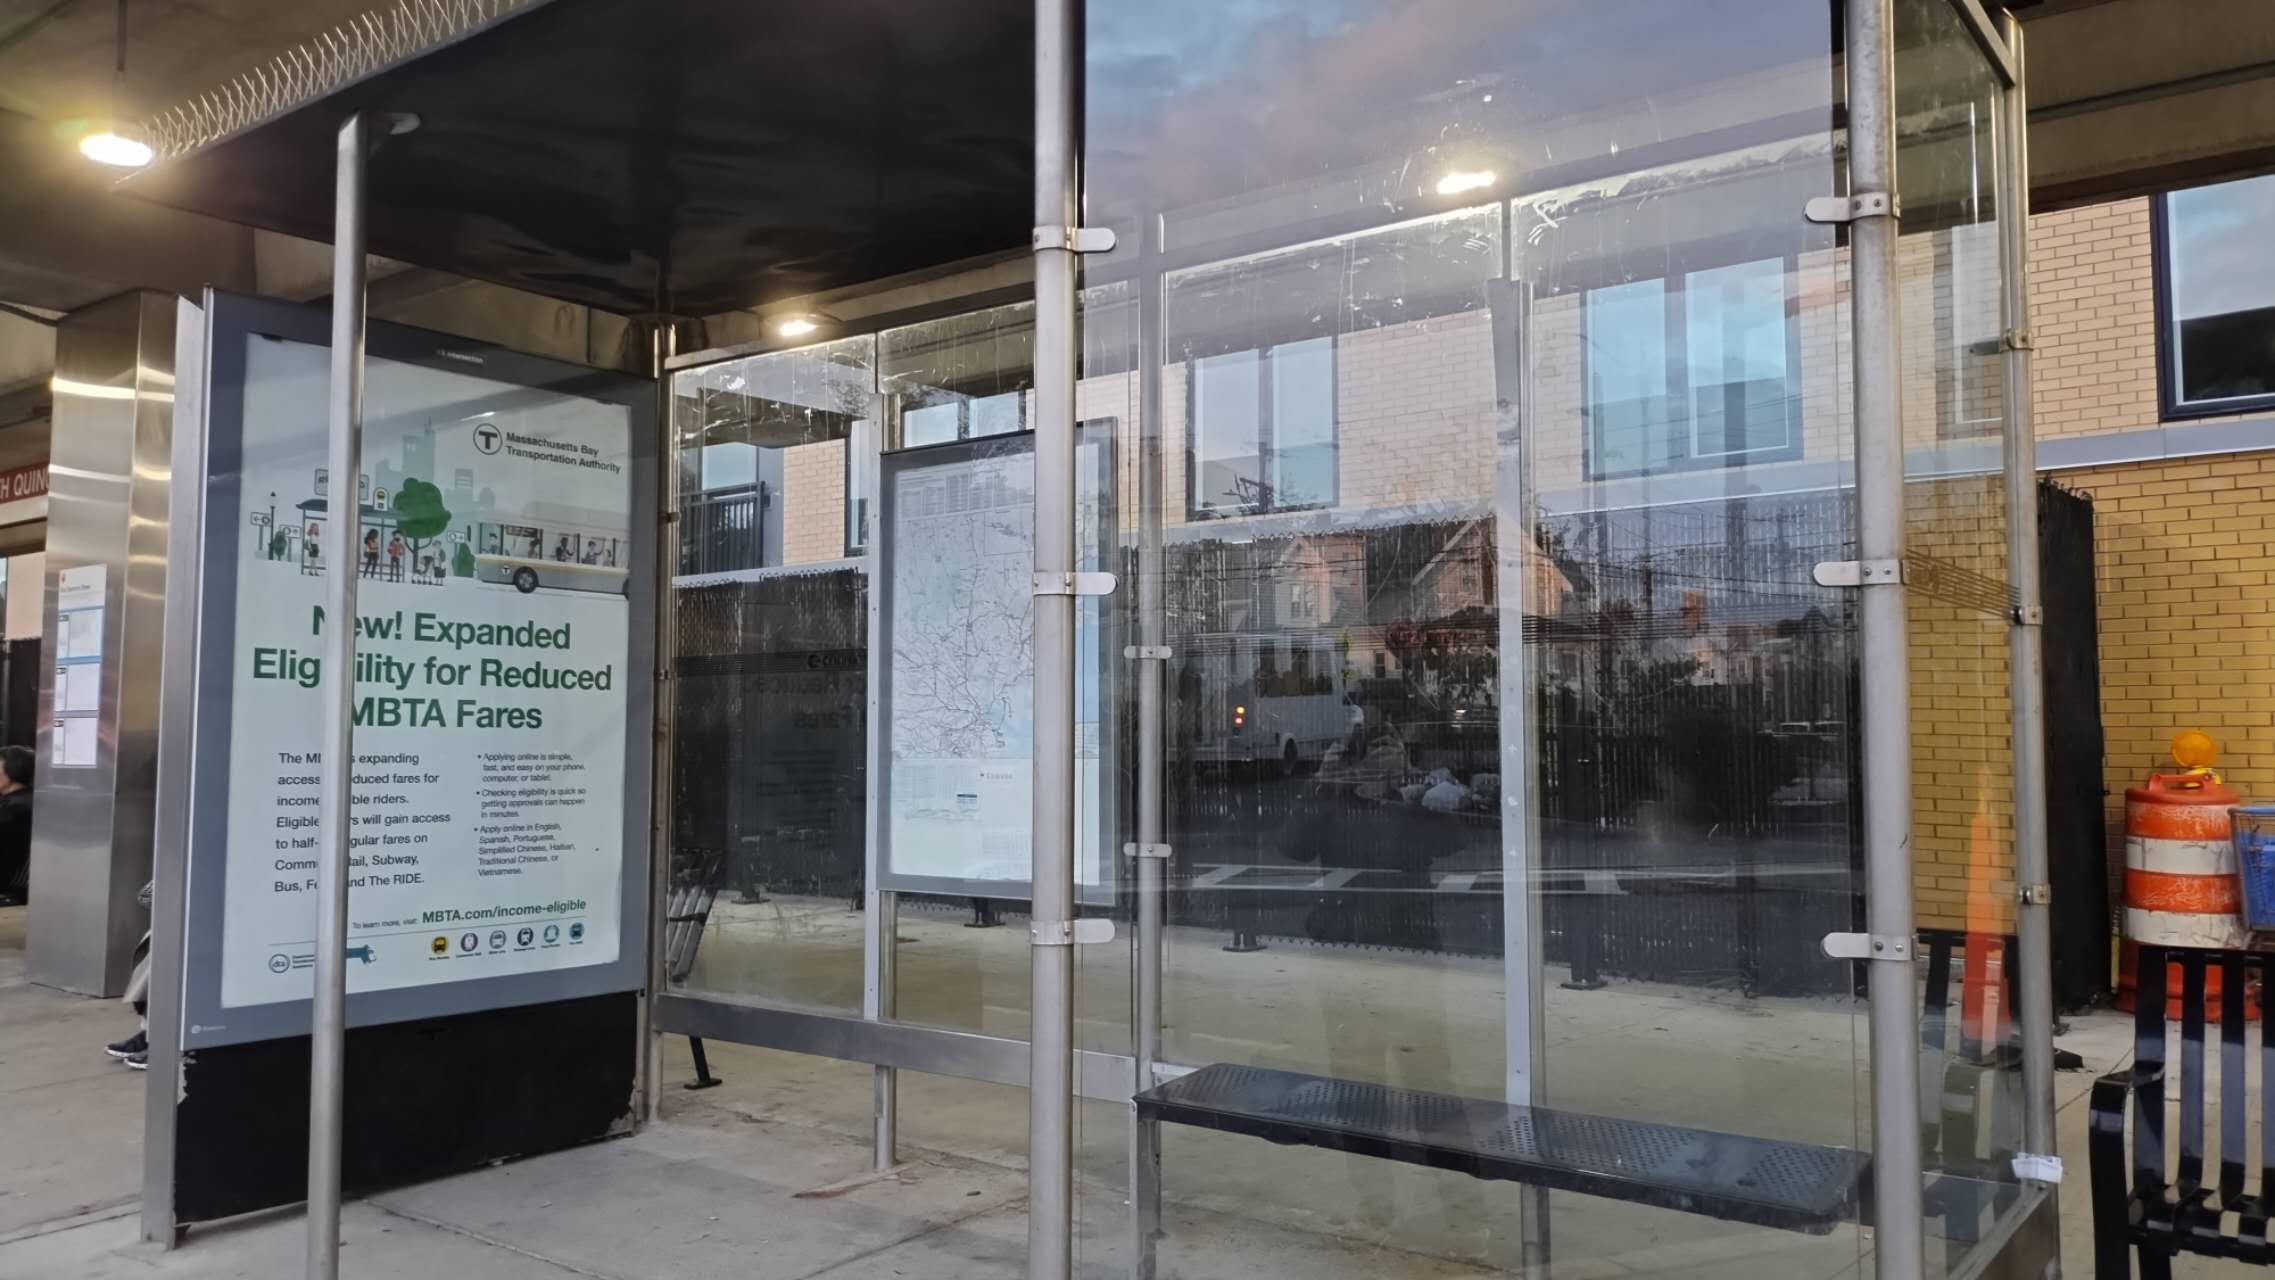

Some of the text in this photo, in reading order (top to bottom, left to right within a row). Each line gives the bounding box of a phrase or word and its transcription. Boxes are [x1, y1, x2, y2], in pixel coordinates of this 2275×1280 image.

[479, 430, 498, 450] T
[506, 432, 600, 458] Massachusetts Bay
[506, 446, 622, 475] Transportation Authority
[13, 468, 49, 497] QUIN
[415, 612, 571, 650] Expanded
[253, 648, 612, 691] Eligility for Reduced
[352, 697, 543, 729] MBTA Fares
[279, 753, 302, 764] The
[359, 752, 420, 766] expanding
[483, 753, 515, 762] Applying
[278, 773, 440, 785] access duced fares for
[373, 793, 409, 805] riders.
[481, 789, 517, 798] Checking
[518, 788, 548, 797] eligibility
[557, 788, 576, 796] quick
[481, 799, 508, 809] getting
[559, 798, 585, 806] happen
[276, 816, 320, 829] Eligible
[362, 814, 381, 825] will
[384, 814, 409, 826] gain
[412, 812, 452, 823] access
[480, 825, 502, 834] Apply
[275, 838, 288, 849] to
[350, 835, 378, 848] gular
[382, 834, 411, 845] fares
[414, 834, 428, 844] on
[274, 854, 419, 871] Comm ail, Subway,
[274, 880, 302, 893] Bus,
[369, 875, 394, 886] The
[393, 873, 424, 885] RIDE.
[422, 899, 587, 924] MBTA.com/income-eligible
